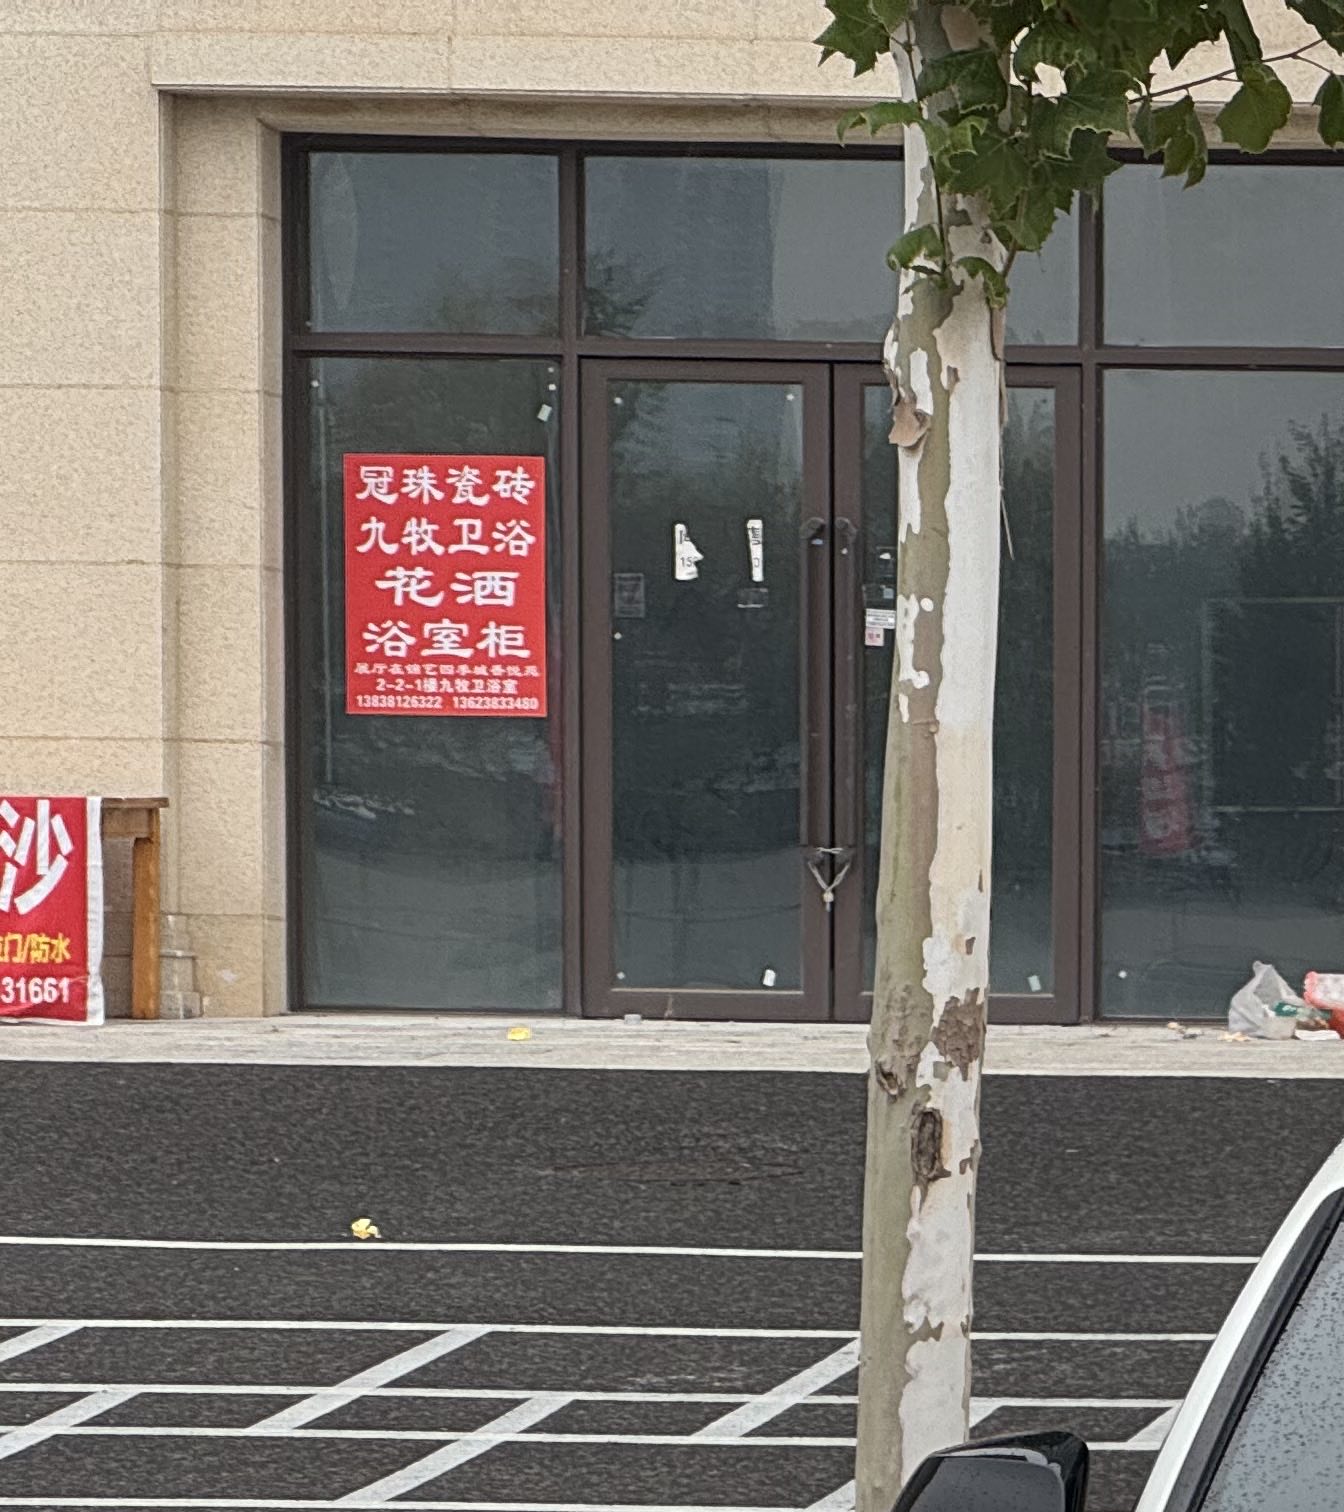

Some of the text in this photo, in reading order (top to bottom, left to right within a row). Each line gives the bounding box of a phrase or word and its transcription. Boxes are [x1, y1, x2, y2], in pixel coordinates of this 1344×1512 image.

[355, 465, 537, 505] 冠珠瓷砖
[356, 516, 537, 557] 九牧卫浴
[375, 566, 520, 607] 花洒
[362, 618, 531, 658] 浴室柜
